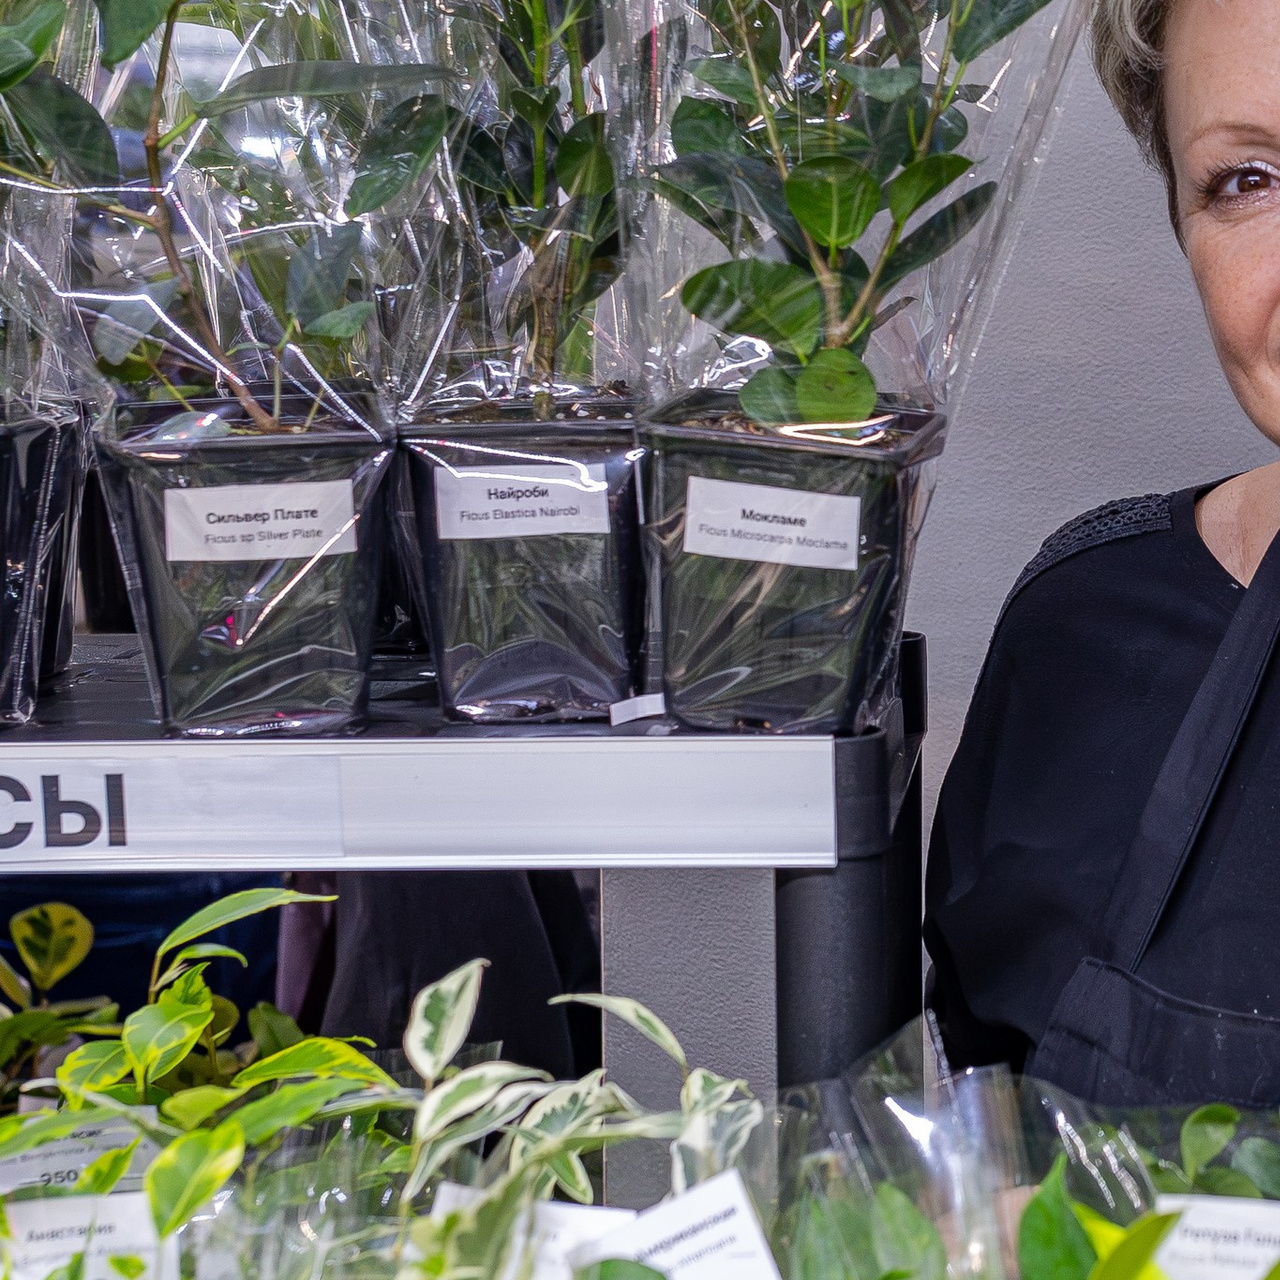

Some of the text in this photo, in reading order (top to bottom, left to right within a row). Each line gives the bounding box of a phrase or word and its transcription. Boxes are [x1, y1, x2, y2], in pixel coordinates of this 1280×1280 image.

[487, 486, 549, 501] Найроби
[206, 508, 318, 525] Сильвер Плате
[460, 505, 580, 522] Ficus Elastica Nairobi
[741, 509, 807, 527] Мокламе
[41, 1170, 79, 1186] 950
